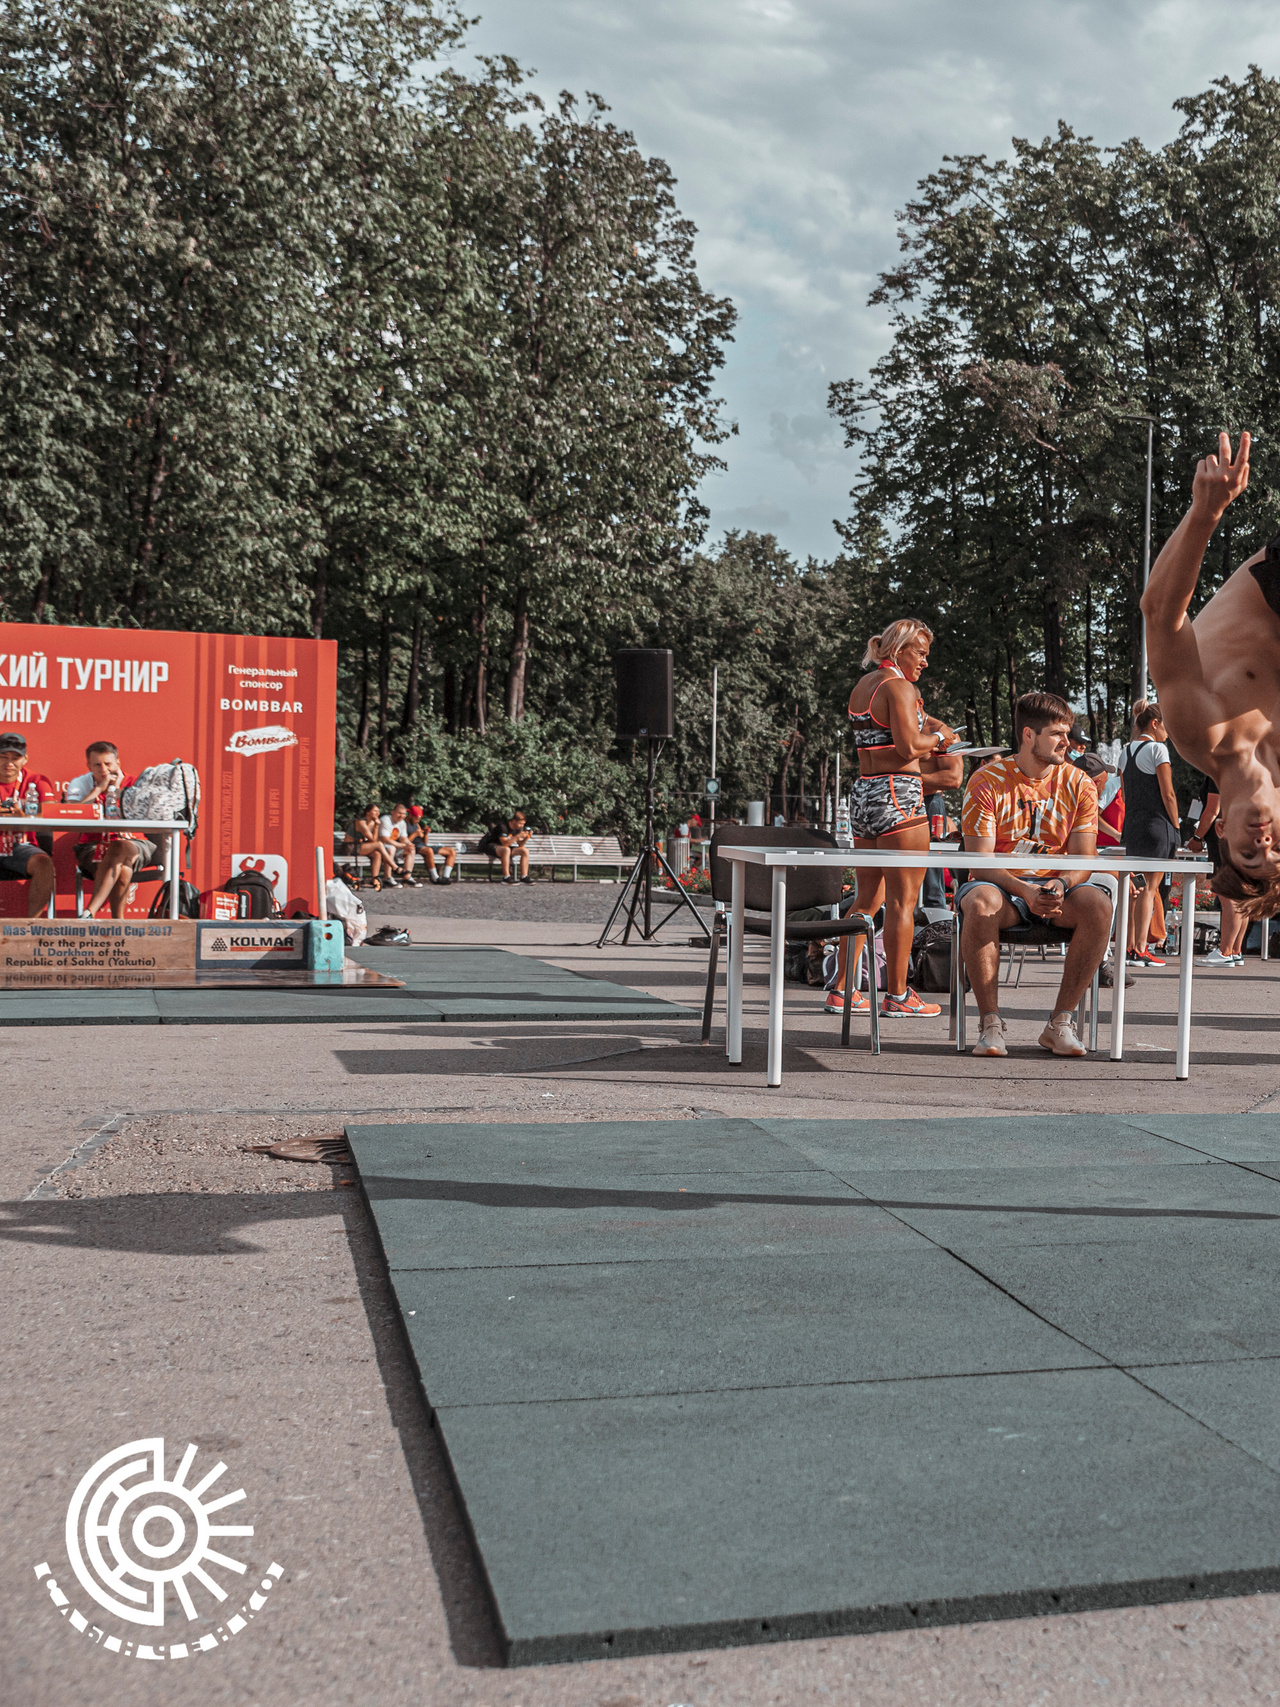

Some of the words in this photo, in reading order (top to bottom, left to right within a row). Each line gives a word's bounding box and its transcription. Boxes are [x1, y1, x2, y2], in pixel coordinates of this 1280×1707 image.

[57, 657, 168, 693] ТУРНИР
[228, 664, 298, 677] Генеральный
[240, 680, 283, 691] спонсор
[220, 698, 303, 713] BOMBBAR
[3, 925, 86, 937] Mas-Wrestling
[88, 926, 122, 936] World
[124, 926, 145, 937] Cup
[148, 926, 172, 936] 2017
[38, 939, 54, 947] for
[58, 939, 76, 947] the
[79, 939, 111, 949] prizes
[114, 939, 126, 947] of
[230, 937, 294, 946] KOLMAR
[48, 948, 94, 956] Darkhan
[98, 948, 109, 956] of
[112, 948, 130, 956] the
[6, 957, 53, 968] Republic
[56, 957, 68, 966] of
[71, 957, 104, 966] Sakha
[108, 957, 156, 967] (Yakutia)
